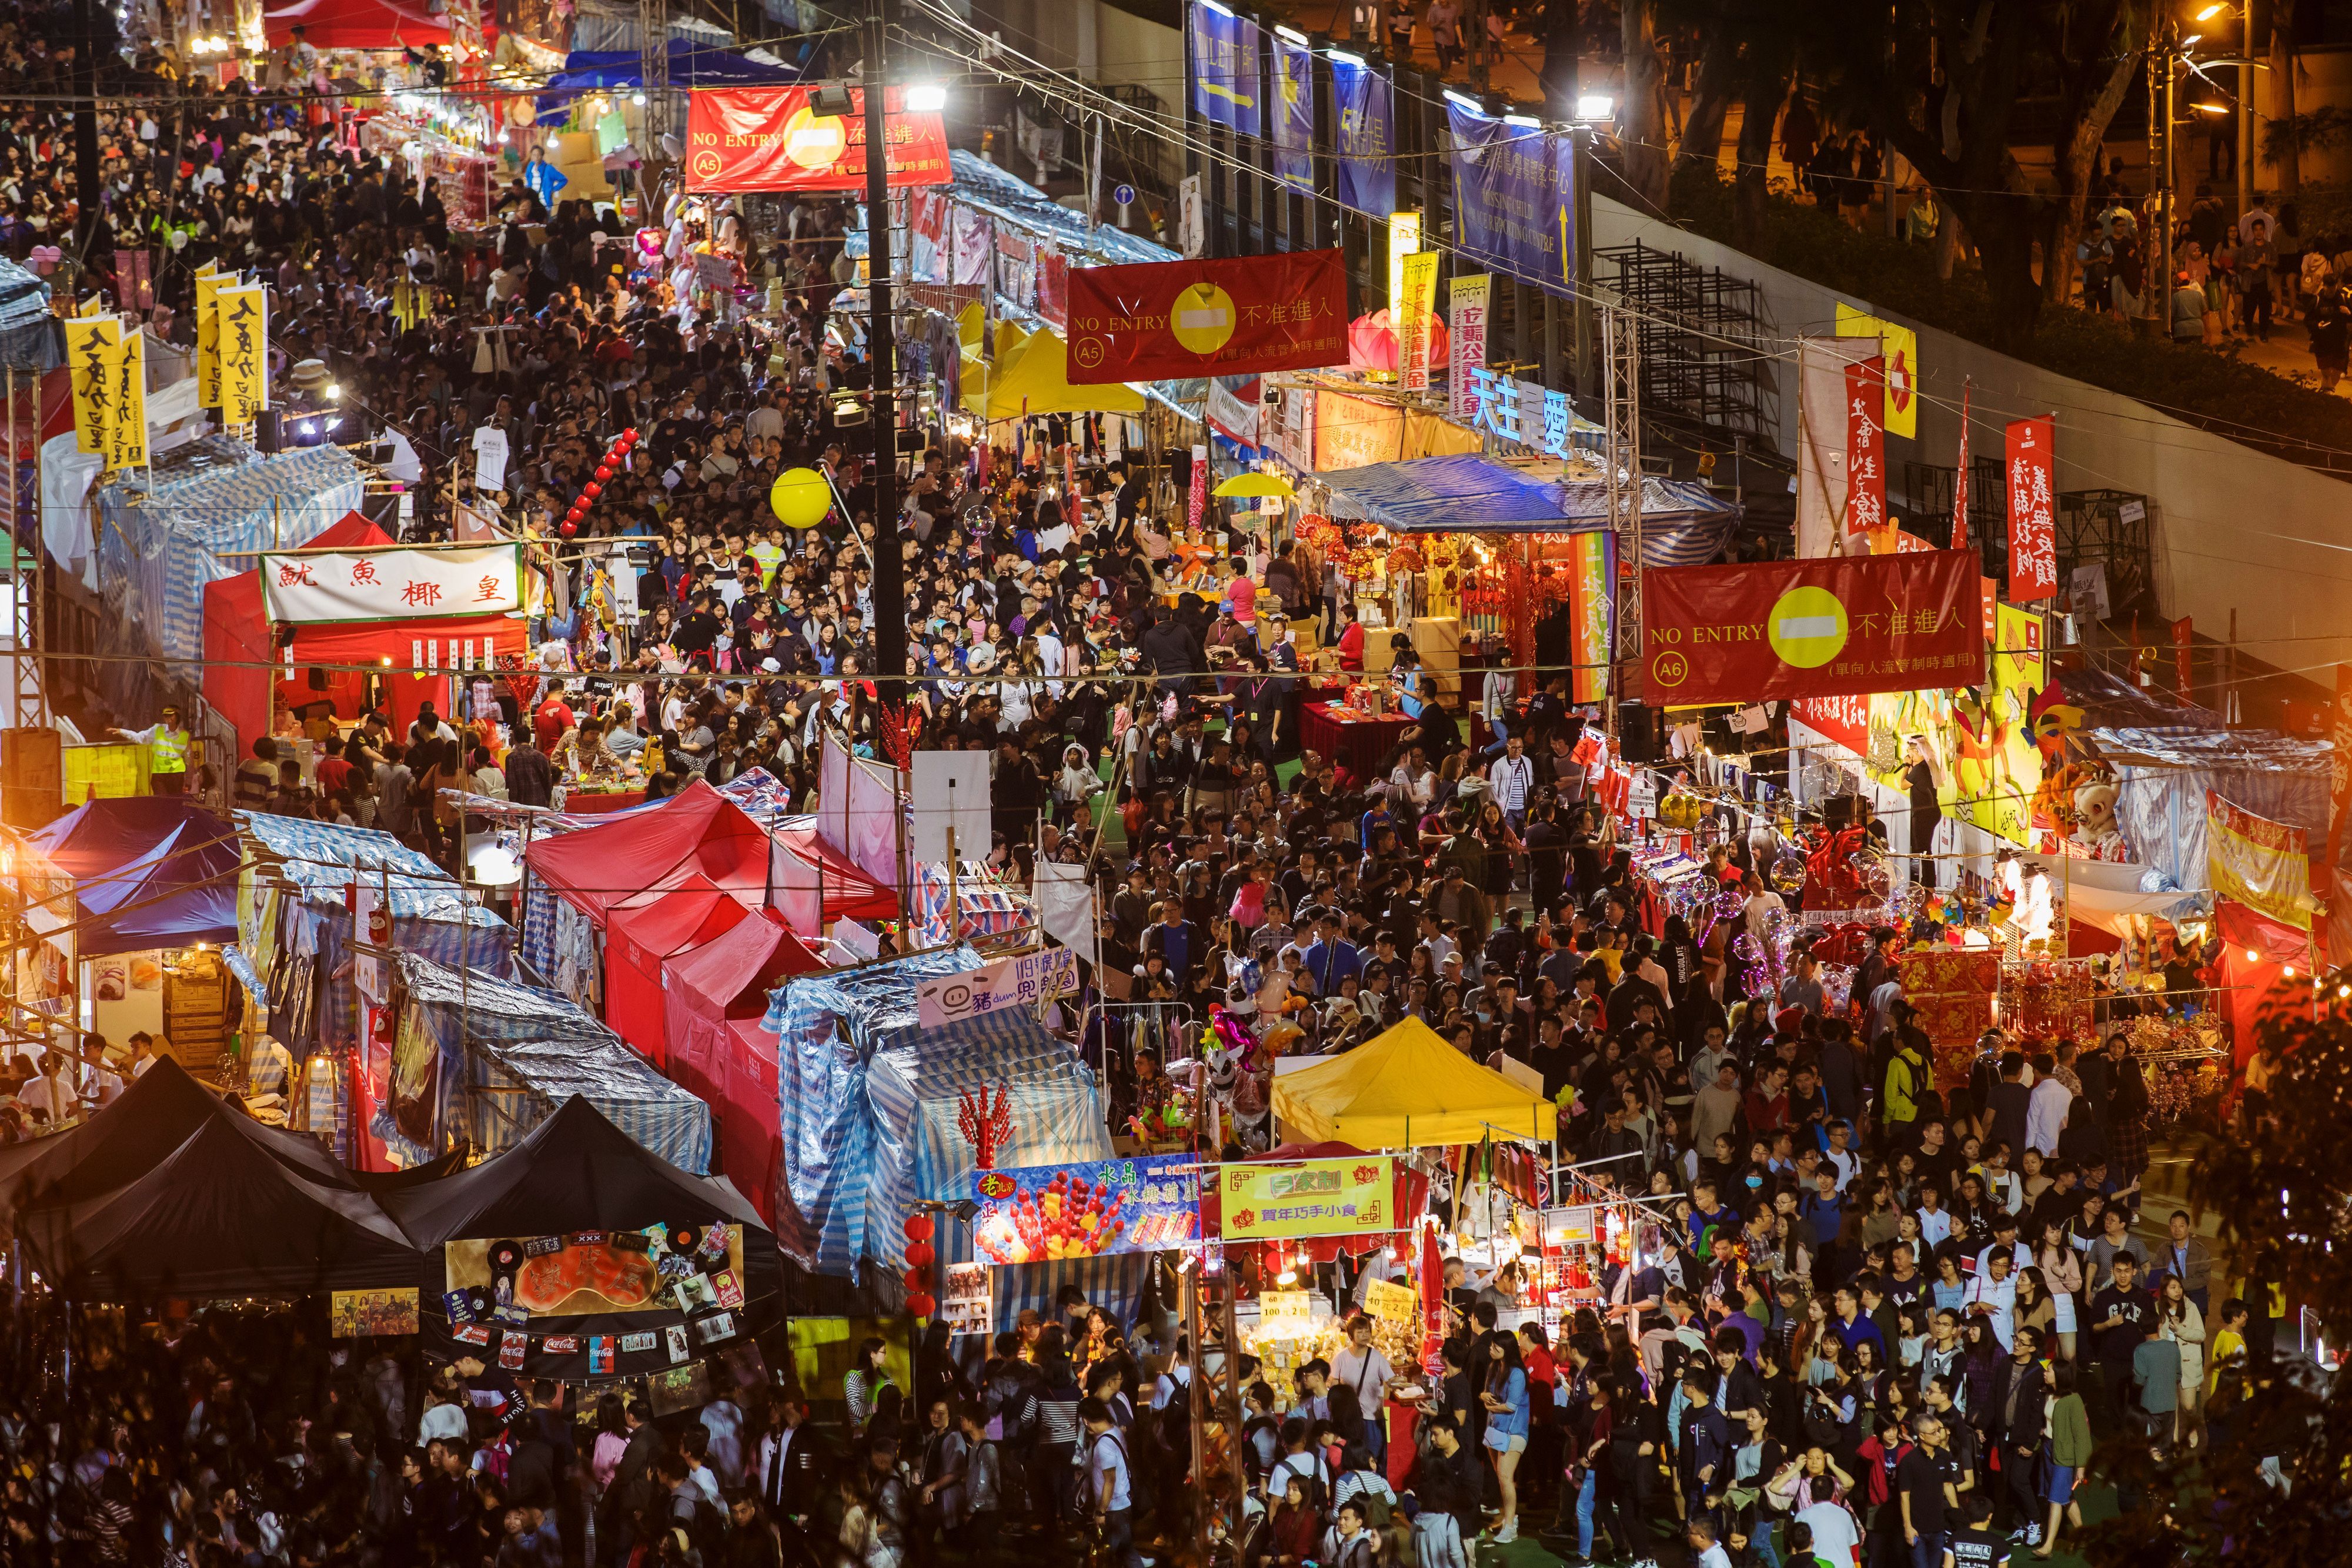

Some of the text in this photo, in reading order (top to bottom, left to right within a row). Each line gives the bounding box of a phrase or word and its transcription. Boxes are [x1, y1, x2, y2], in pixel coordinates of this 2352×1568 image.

[693, 132, 781, 148] NO ENTRY
[848, 121, 935, 145] 不進入
[699, 158, 717, 170] A5
[830, 158, 944, 177] (單向人制時適用)
[1241, 296, 1334, 327] 不准進入
[1073, 315, 1168, 332] NO ENTRY
[1080, 346, 1099, 360] A5
[279, 559, 506, 607] 魷魚椰皇
[1854, 606, 1967, 639] 不准進入
[1651, 623, 1765, 646] NO ENTRY
[1660, 663, 1682, 677] A6
[1828, 653, 1977, 678] (單向人流管制時適用)
[1097, 1162, 1137, 1186] 水晶
[982, 1174, 1015, 1197] 老北京
[1261, 1204, 1358, 1222] 賀年巧手小食
[720, 1284, 738, 1300] Smile
[1374, 1284, 1385, 1293] 30
[453, 1303, 465, 1311] CALM
[1368, 1297, 1380, 1306] 40
[456, 1310, 467, 1318] KEEP
[1264, 1308, 1279, 1316] 100
